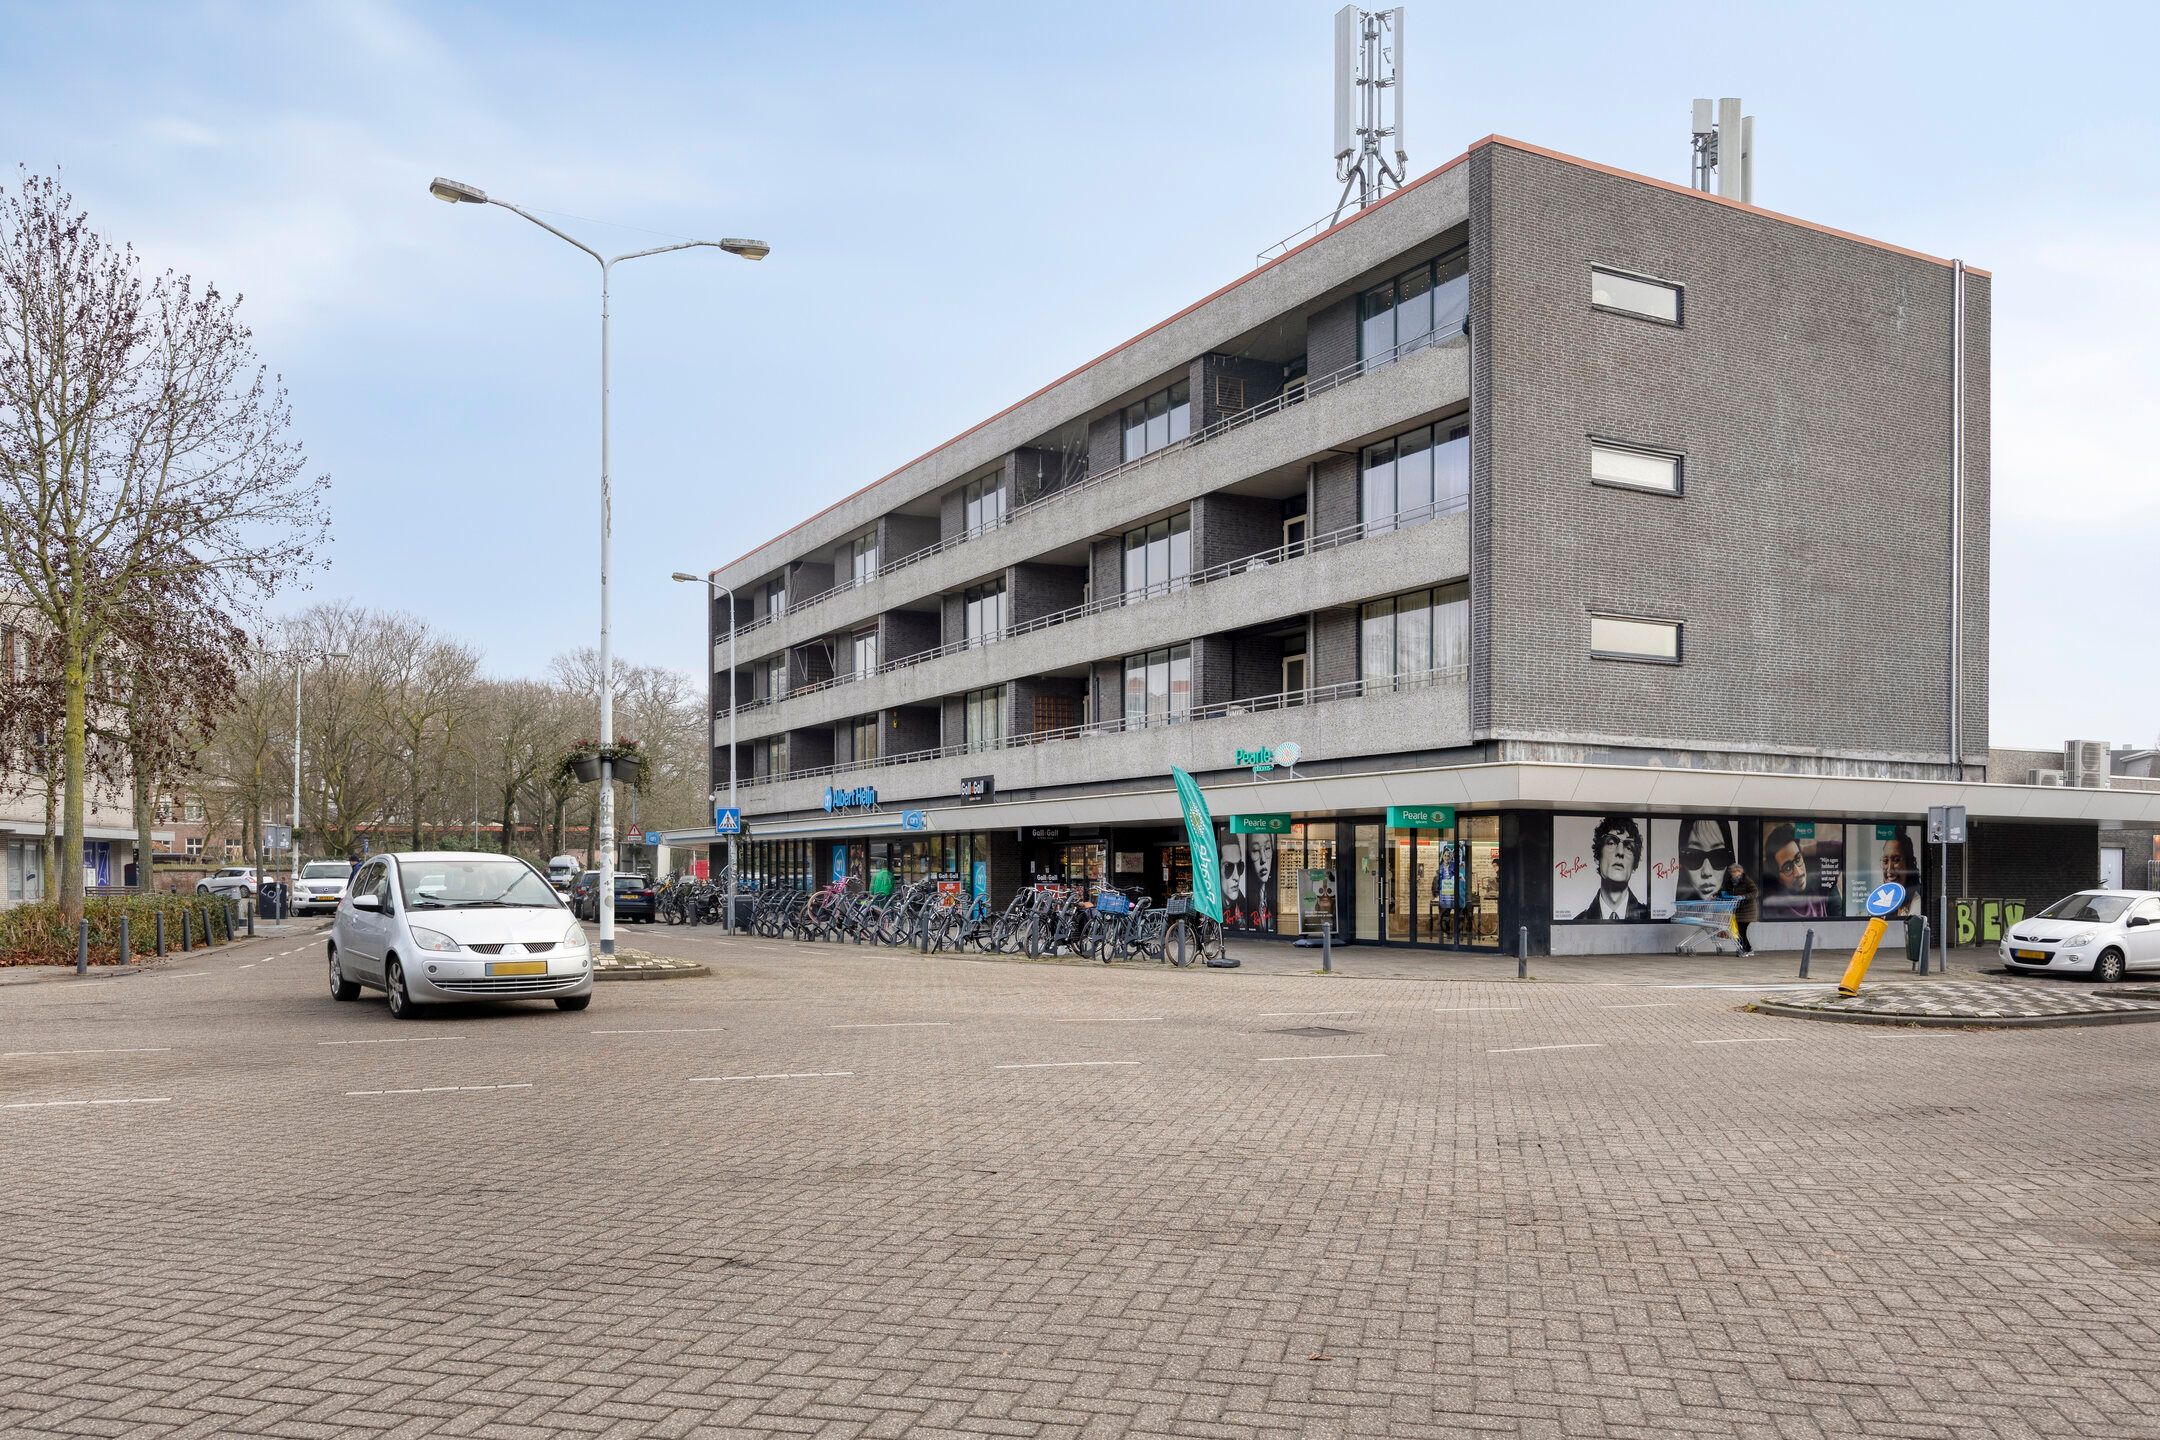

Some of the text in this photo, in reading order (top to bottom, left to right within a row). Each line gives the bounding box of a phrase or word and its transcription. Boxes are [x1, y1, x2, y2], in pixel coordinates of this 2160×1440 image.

[1236, 746, 1271, 765] Pearle
[833, 787, 856, 806] Albert
[856, 784, 876, 807] Heijn
[1244, 819, 1267, 827] Pearle
[1403, 811, 1428, 820] Pearle
[1200, 844, 1216, 904] Pearle
[1555, 857, 1588, 878] Ray-Ban
